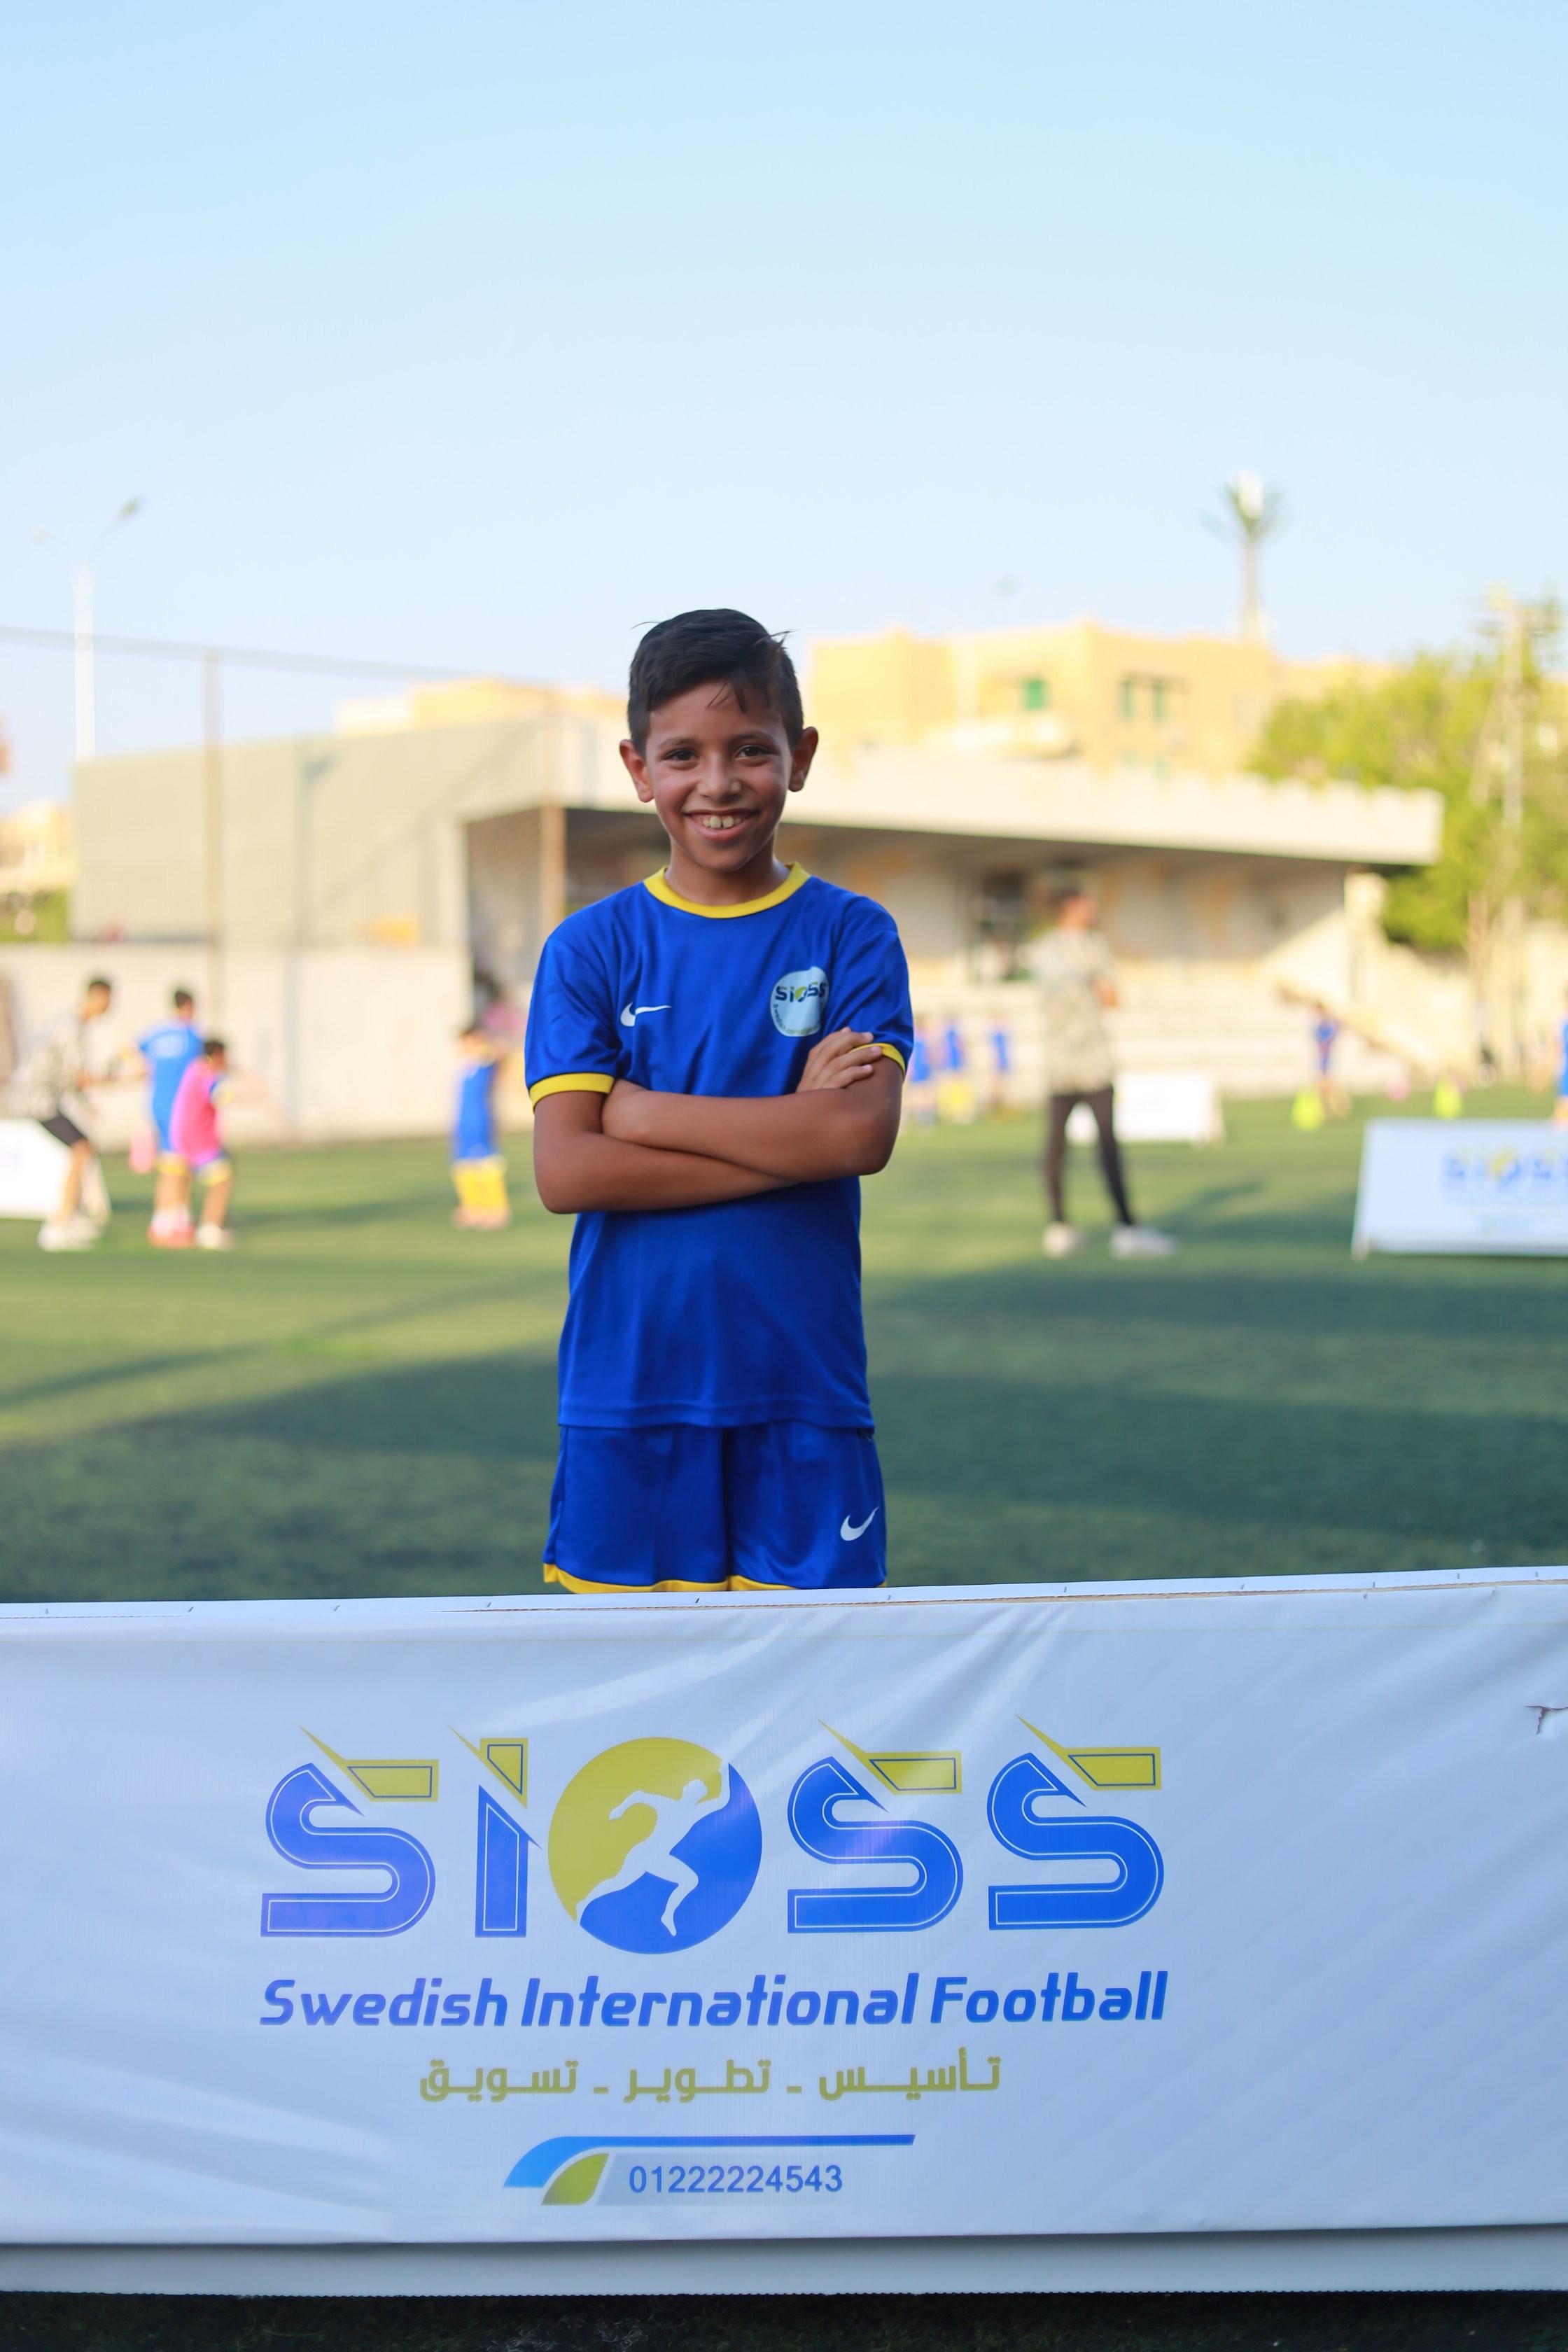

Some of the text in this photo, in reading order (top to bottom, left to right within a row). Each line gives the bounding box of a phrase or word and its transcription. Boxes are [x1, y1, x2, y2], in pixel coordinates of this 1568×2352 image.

[260, 1970, 1169, 2027] Swedish International Football
[418, 2057, 580, 2104] تسويق
[622, 2057, 773, 2105] تطوير
[817, 2045, 1003, 2103] تأسيس
[629, 2164, 843, 2194] 01222224543
